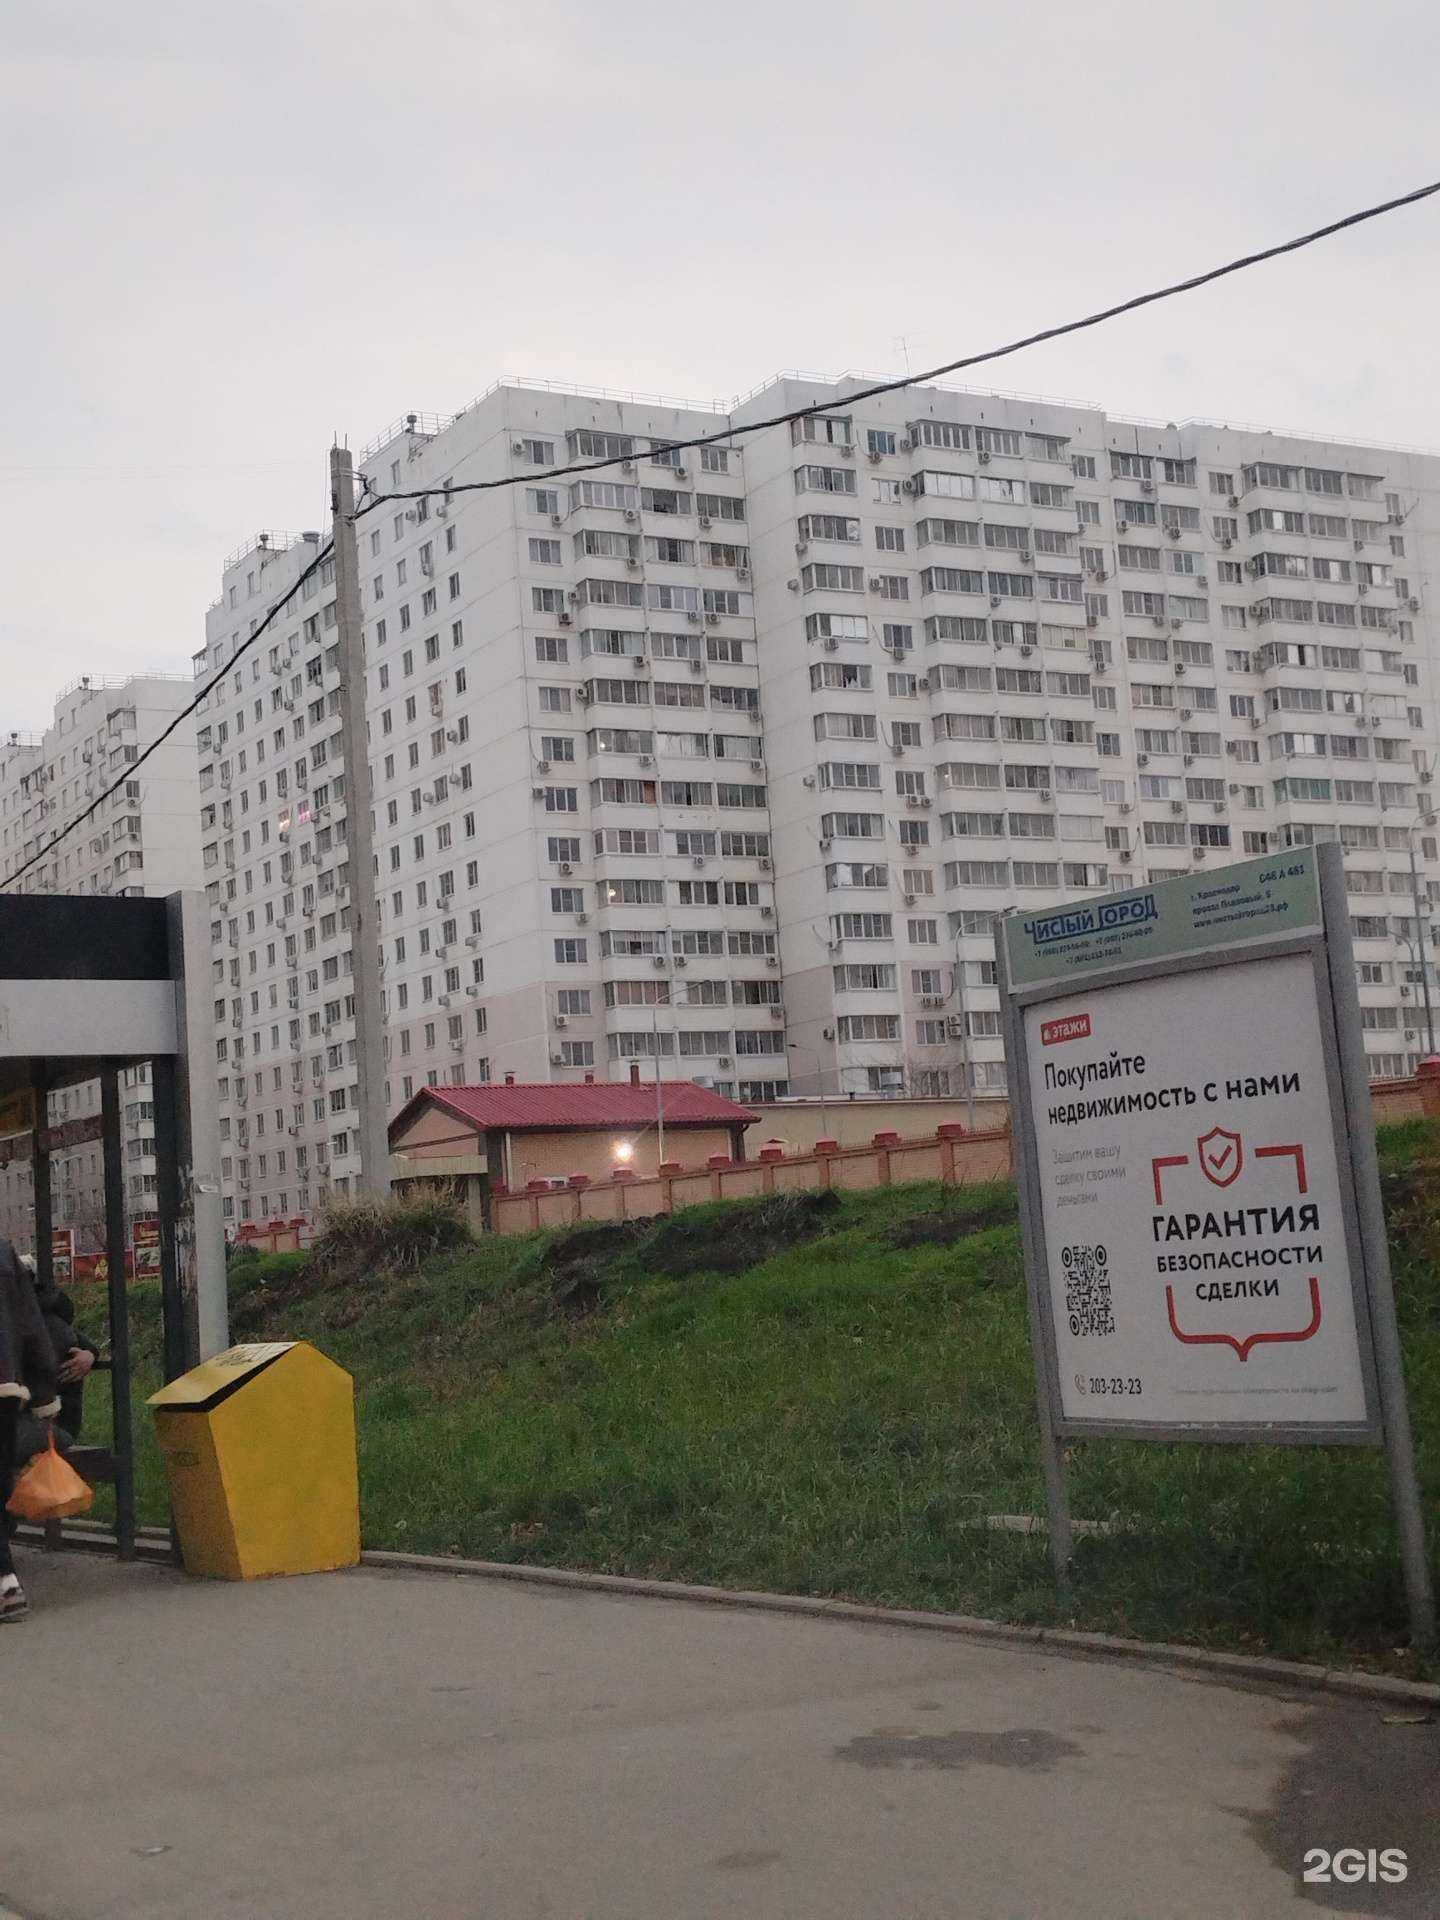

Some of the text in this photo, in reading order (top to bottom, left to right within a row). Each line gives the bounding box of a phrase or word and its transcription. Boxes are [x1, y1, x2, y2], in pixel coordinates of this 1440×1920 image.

[1044, 1050, 1145, 1091] Покупайте
[1048, 1072, 1300, 1126] недвижимость с нами
[1087, 1167, 1126, 1181] своими
[1152, 1203, 1320, 1242] ГАРАНТИЯ
[1157, 1245, 1323, 1273] БЕЗОПАСНОСТИ
[1196, 1279, 1279, 1302] СДЕЛКИ
[1089, 1378, 1142, 1395] 203-23-23
